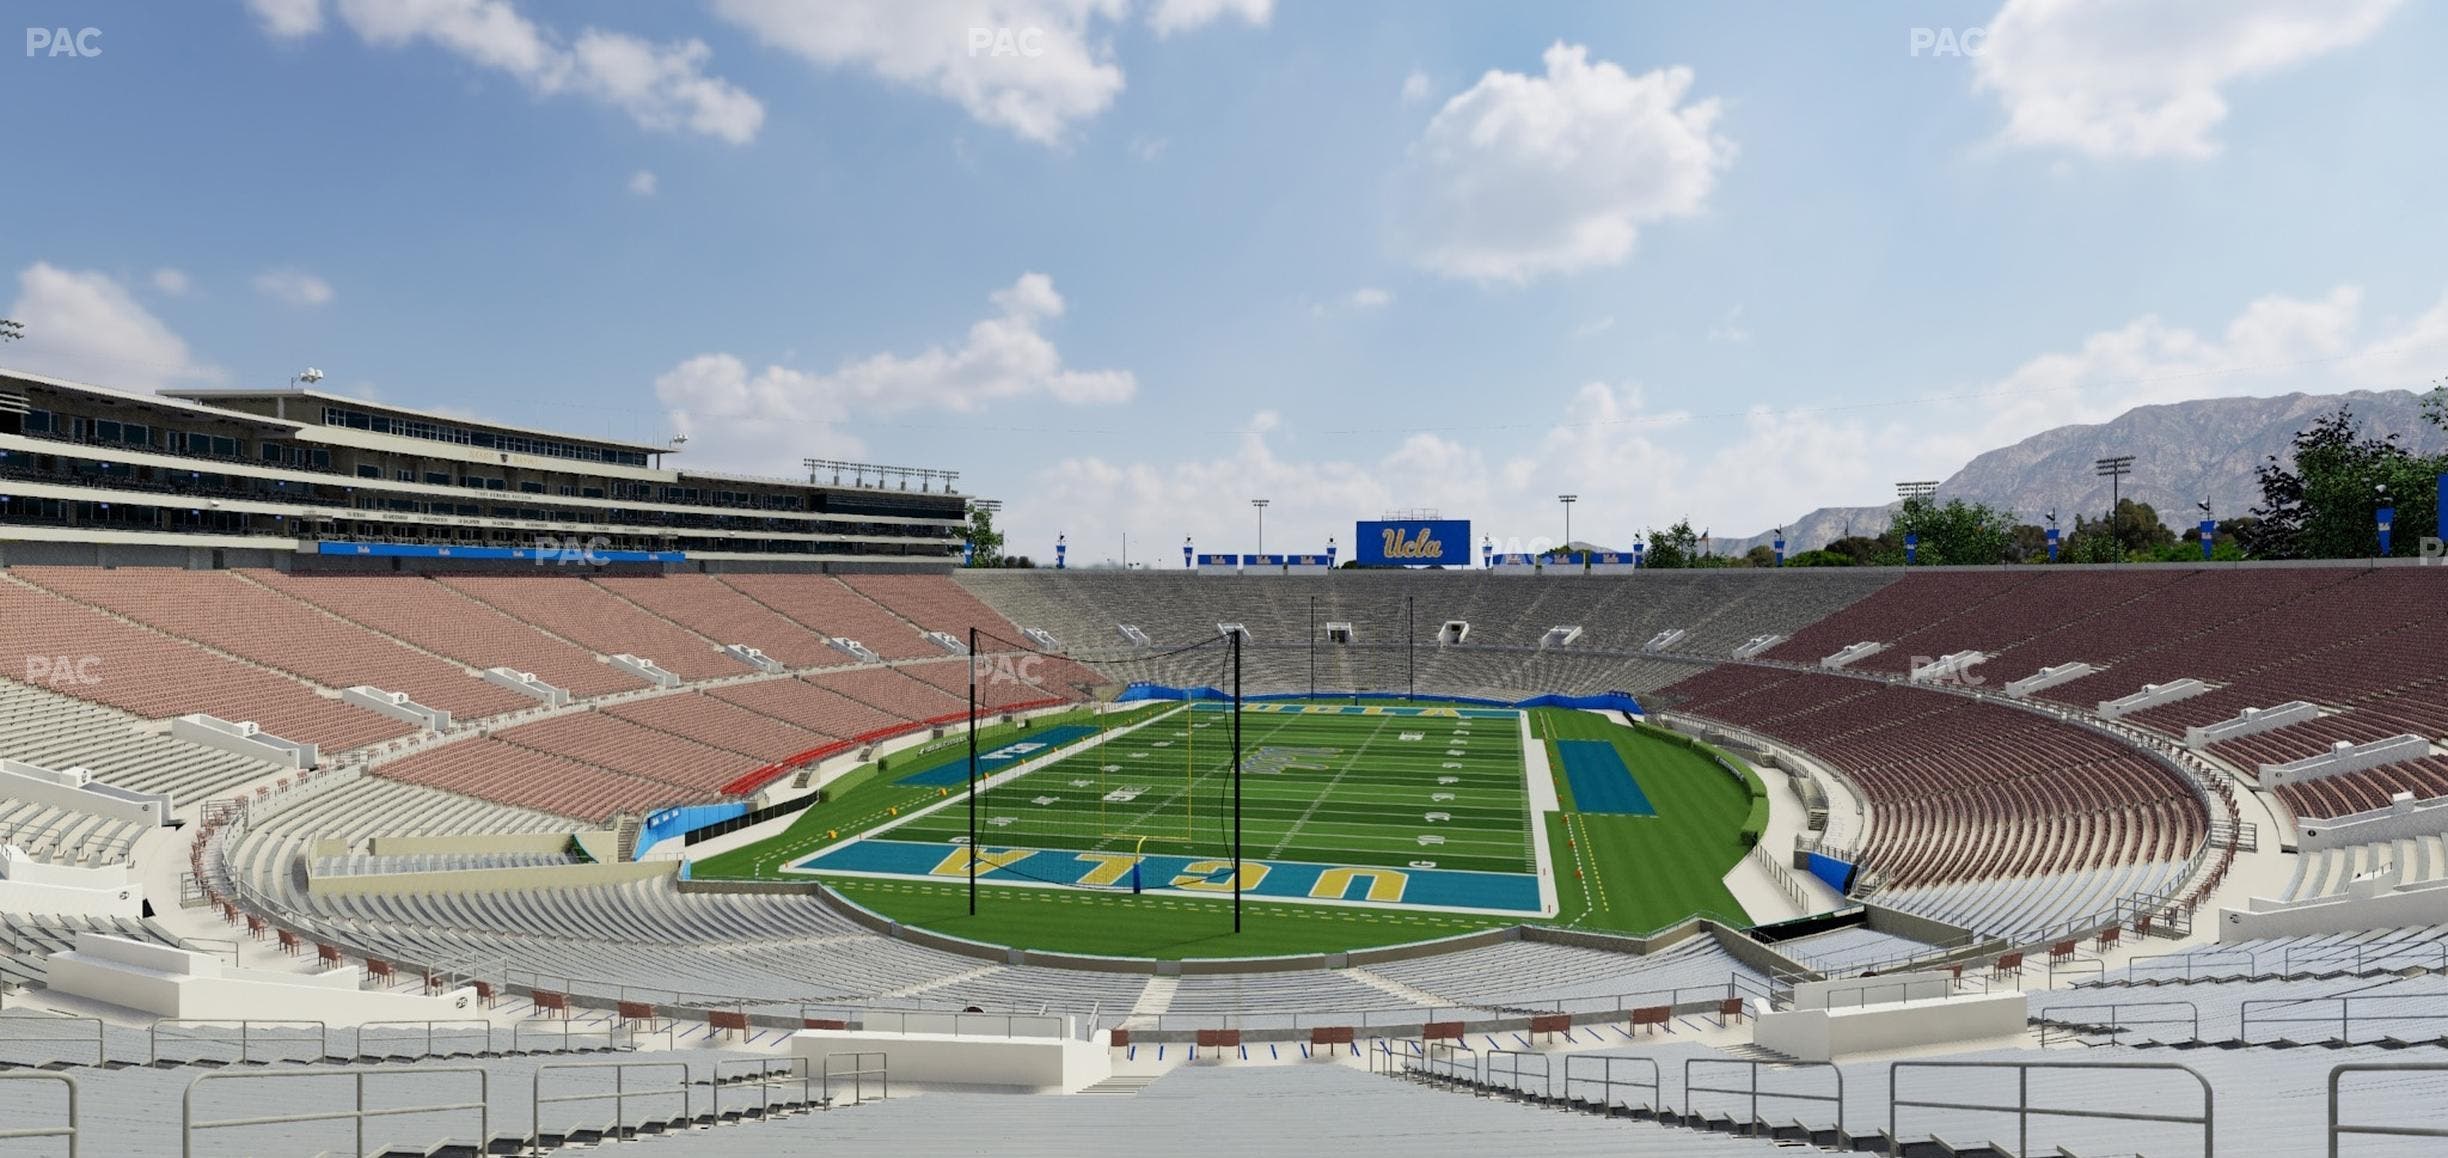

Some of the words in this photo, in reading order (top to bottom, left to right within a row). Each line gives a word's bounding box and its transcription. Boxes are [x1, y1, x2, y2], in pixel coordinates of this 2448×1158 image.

[1382, 528, 1443, 558] Ucla
[1241, 703, 1461, 717] UCLA
[929, 846, 1410, 902] UCLA
